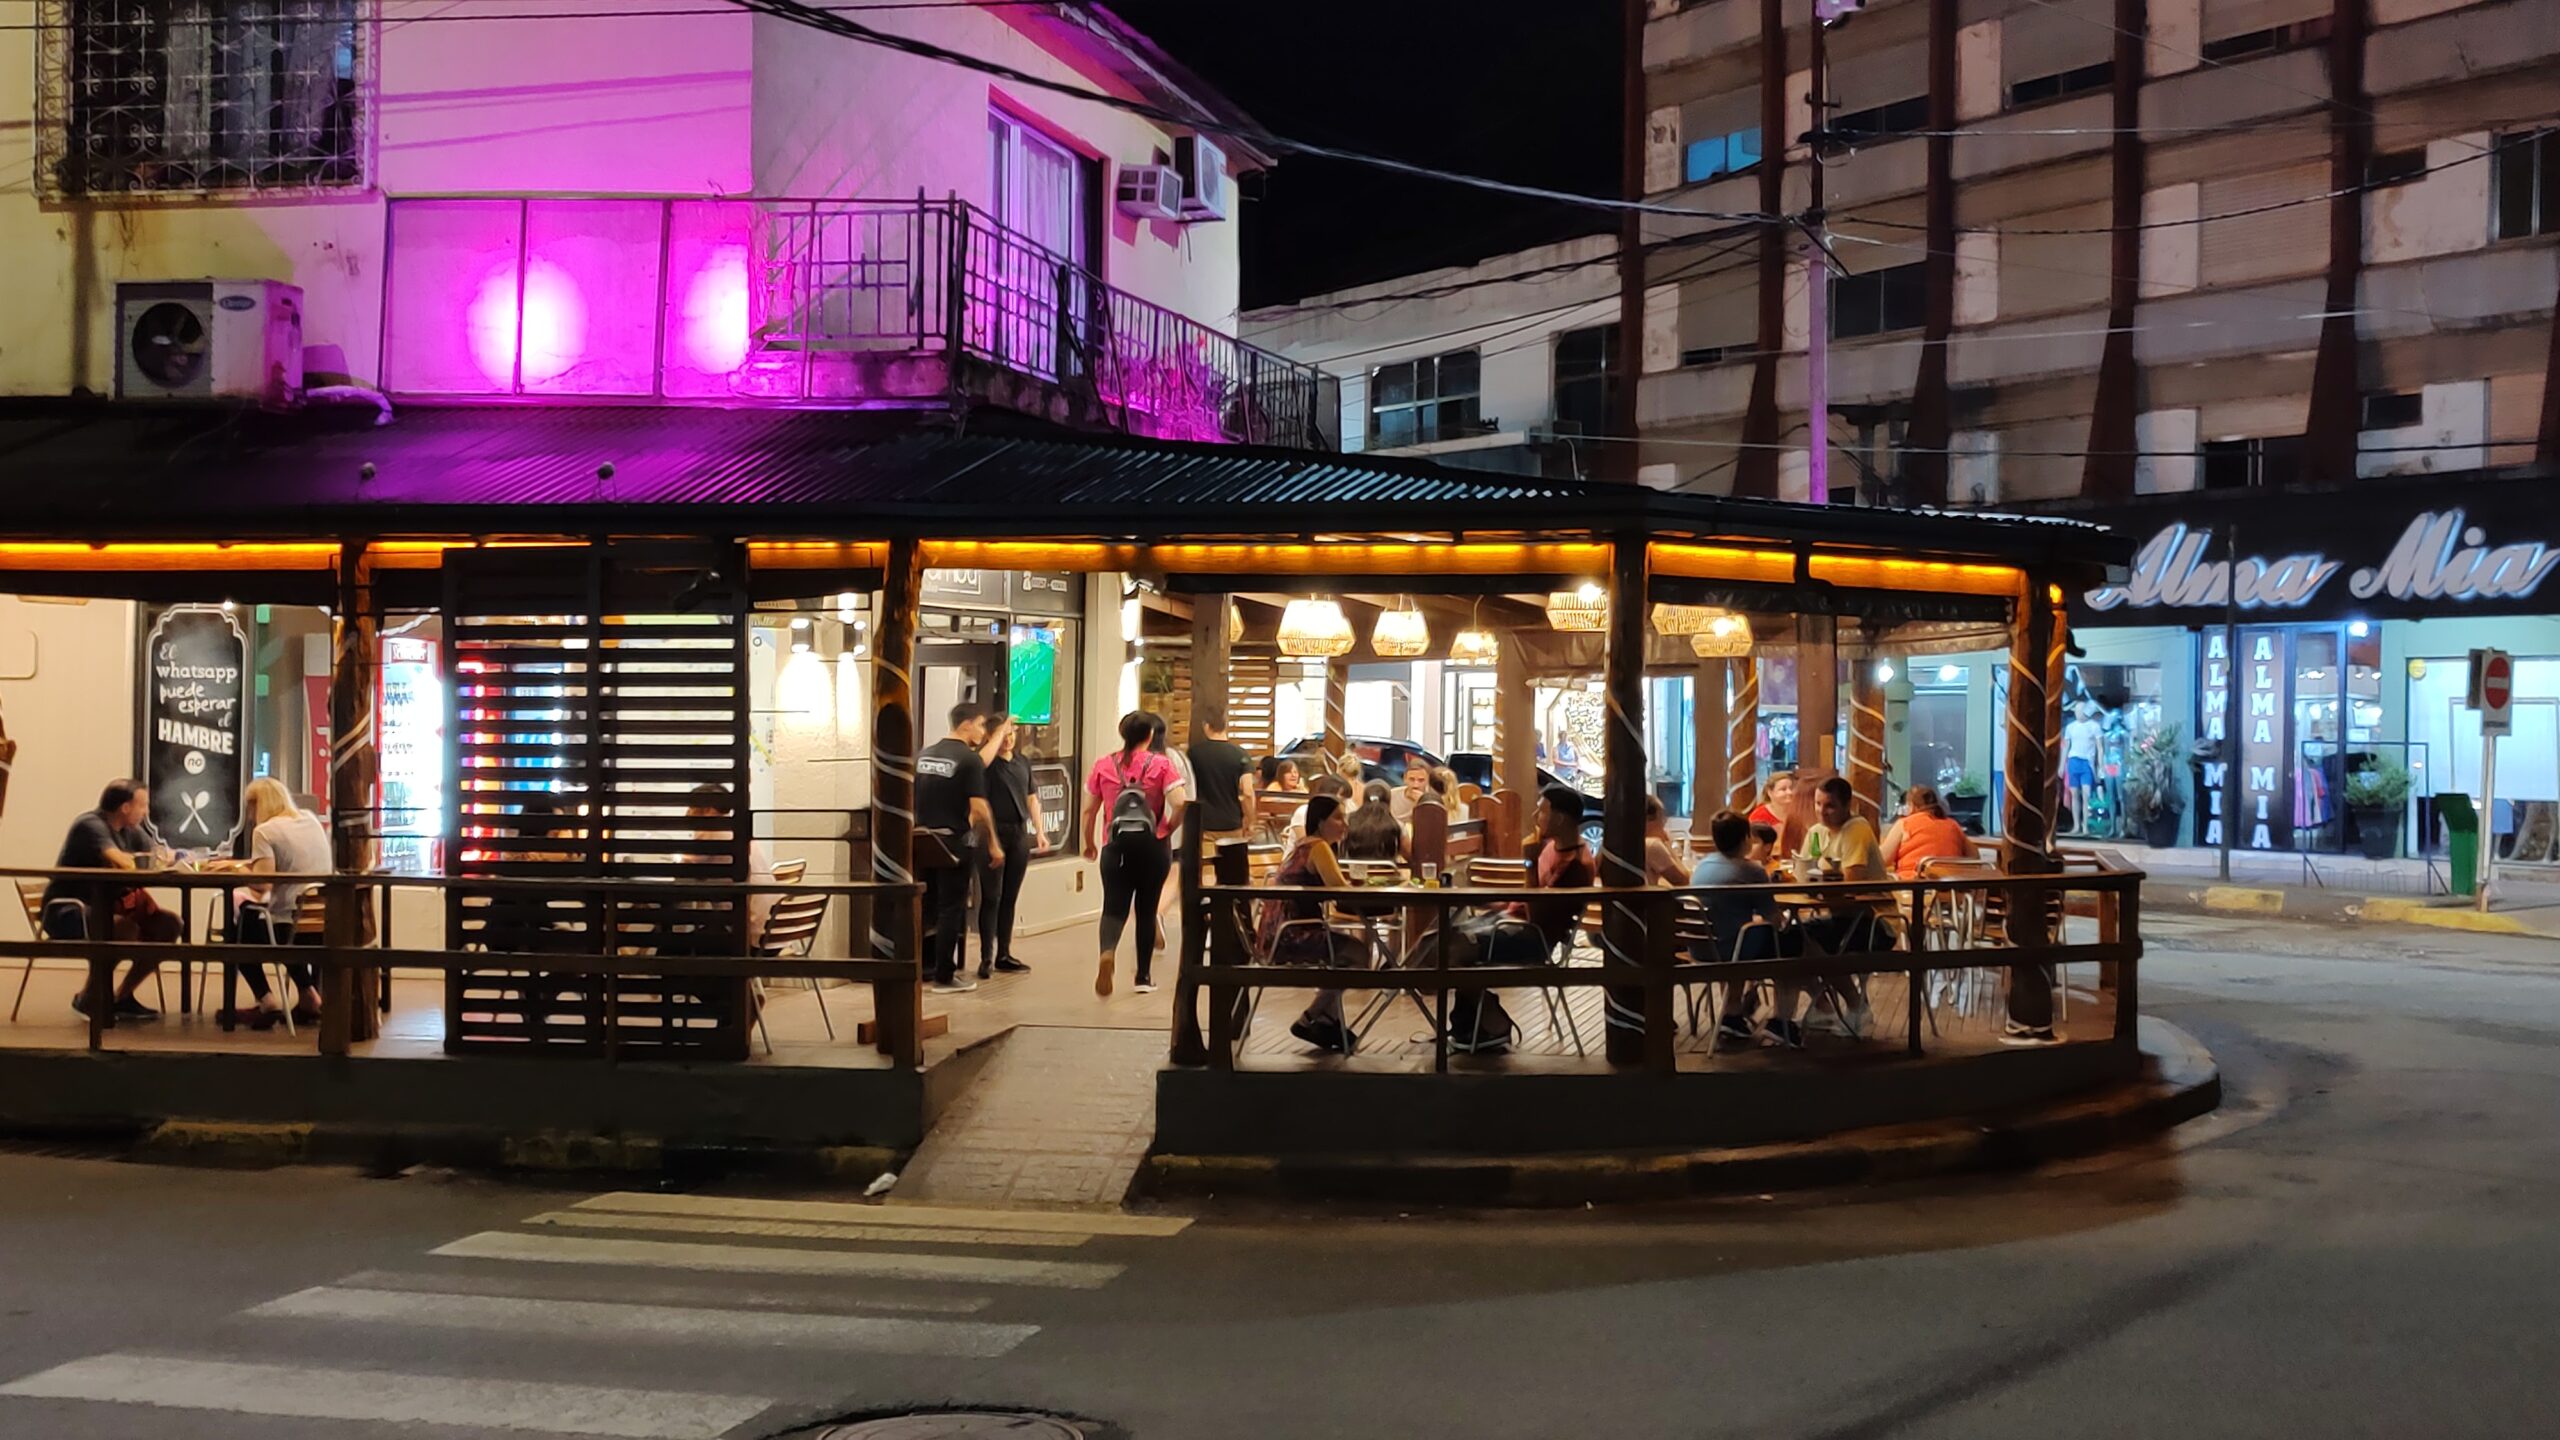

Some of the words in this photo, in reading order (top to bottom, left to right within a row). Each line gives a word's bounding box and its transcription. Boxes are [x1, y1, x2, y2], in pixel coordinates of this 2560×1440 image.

[2084, 522, 2343, 610] Alma
[2349, 508, 2560, 599] Mia
[159, 642, 177, 660] El
[156, 661, 238, 684] whatsapp
[2207, 634, 2228, 740] ALMA
[160, 682, 205, 704] puede
[2250, 636, 2274, 743] ALMA
[178, 698, 236, 716] esperar
[218, 712, 232, 728] el
[158, 718, 234, 755] HAMBRE
[187, 755, 203, 768] no
[2204, 762, 2227, 844] MIA
[2251, 766, 2275, 849] MIA
